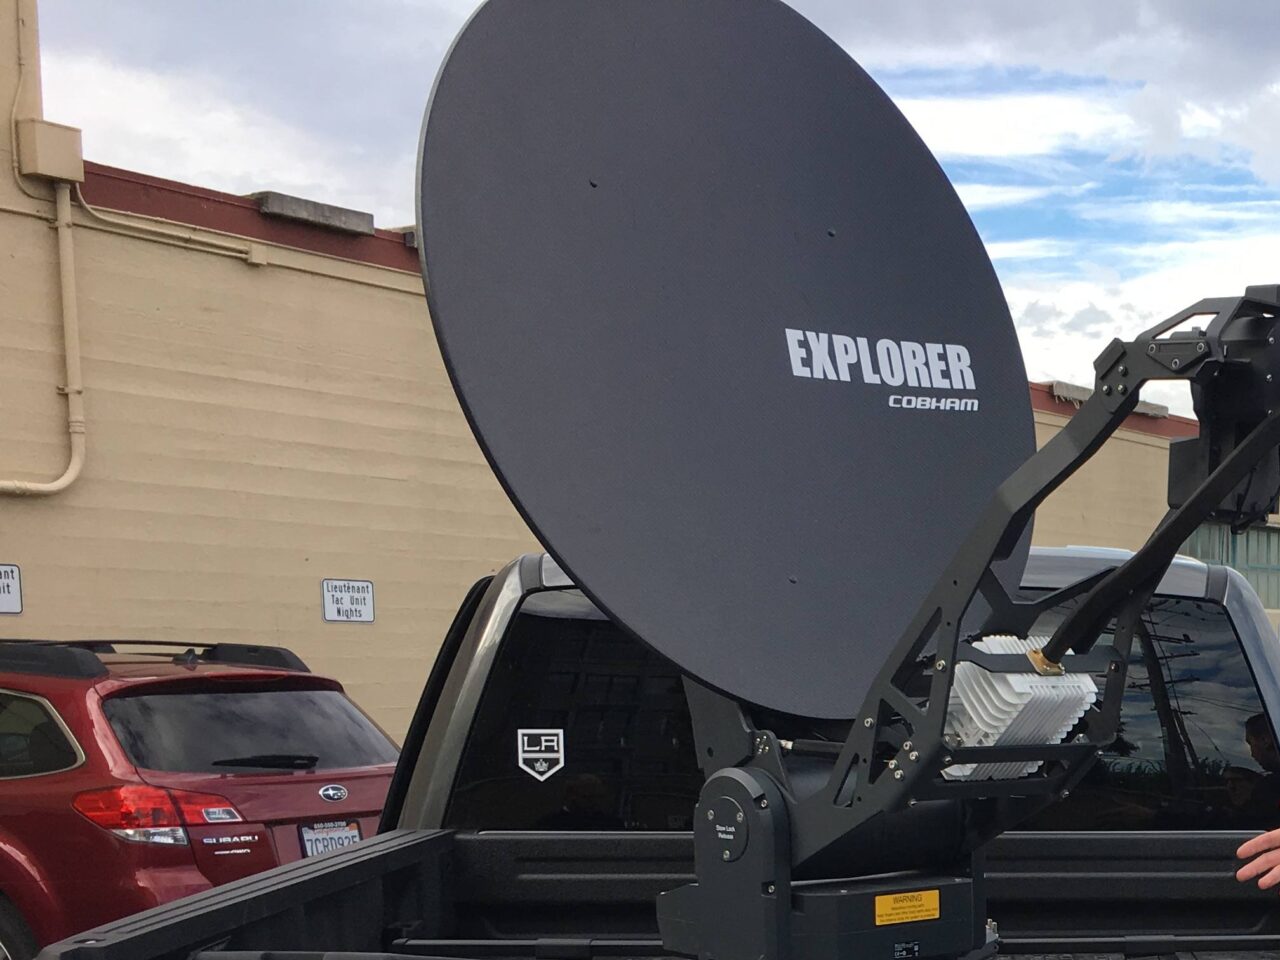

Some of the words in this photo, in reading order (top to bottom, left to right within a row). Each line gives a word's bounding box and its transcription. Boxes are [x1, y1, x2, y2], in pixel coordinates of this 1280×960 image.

[785, 328, 976, 390] EXPLORER
[888, 395, 979, 411] COBHAM
[326, 582, 369, 594] Lieutenant
[331, 594, 343, 605] Tac
[350, 595, 366, 606] Unit
[337, 607, 362, 619] Nights
[523, 736, 558, 751] LA
[203, 835, 258, 844] SUBARU
[893, 894, 922, 904] WARNING
